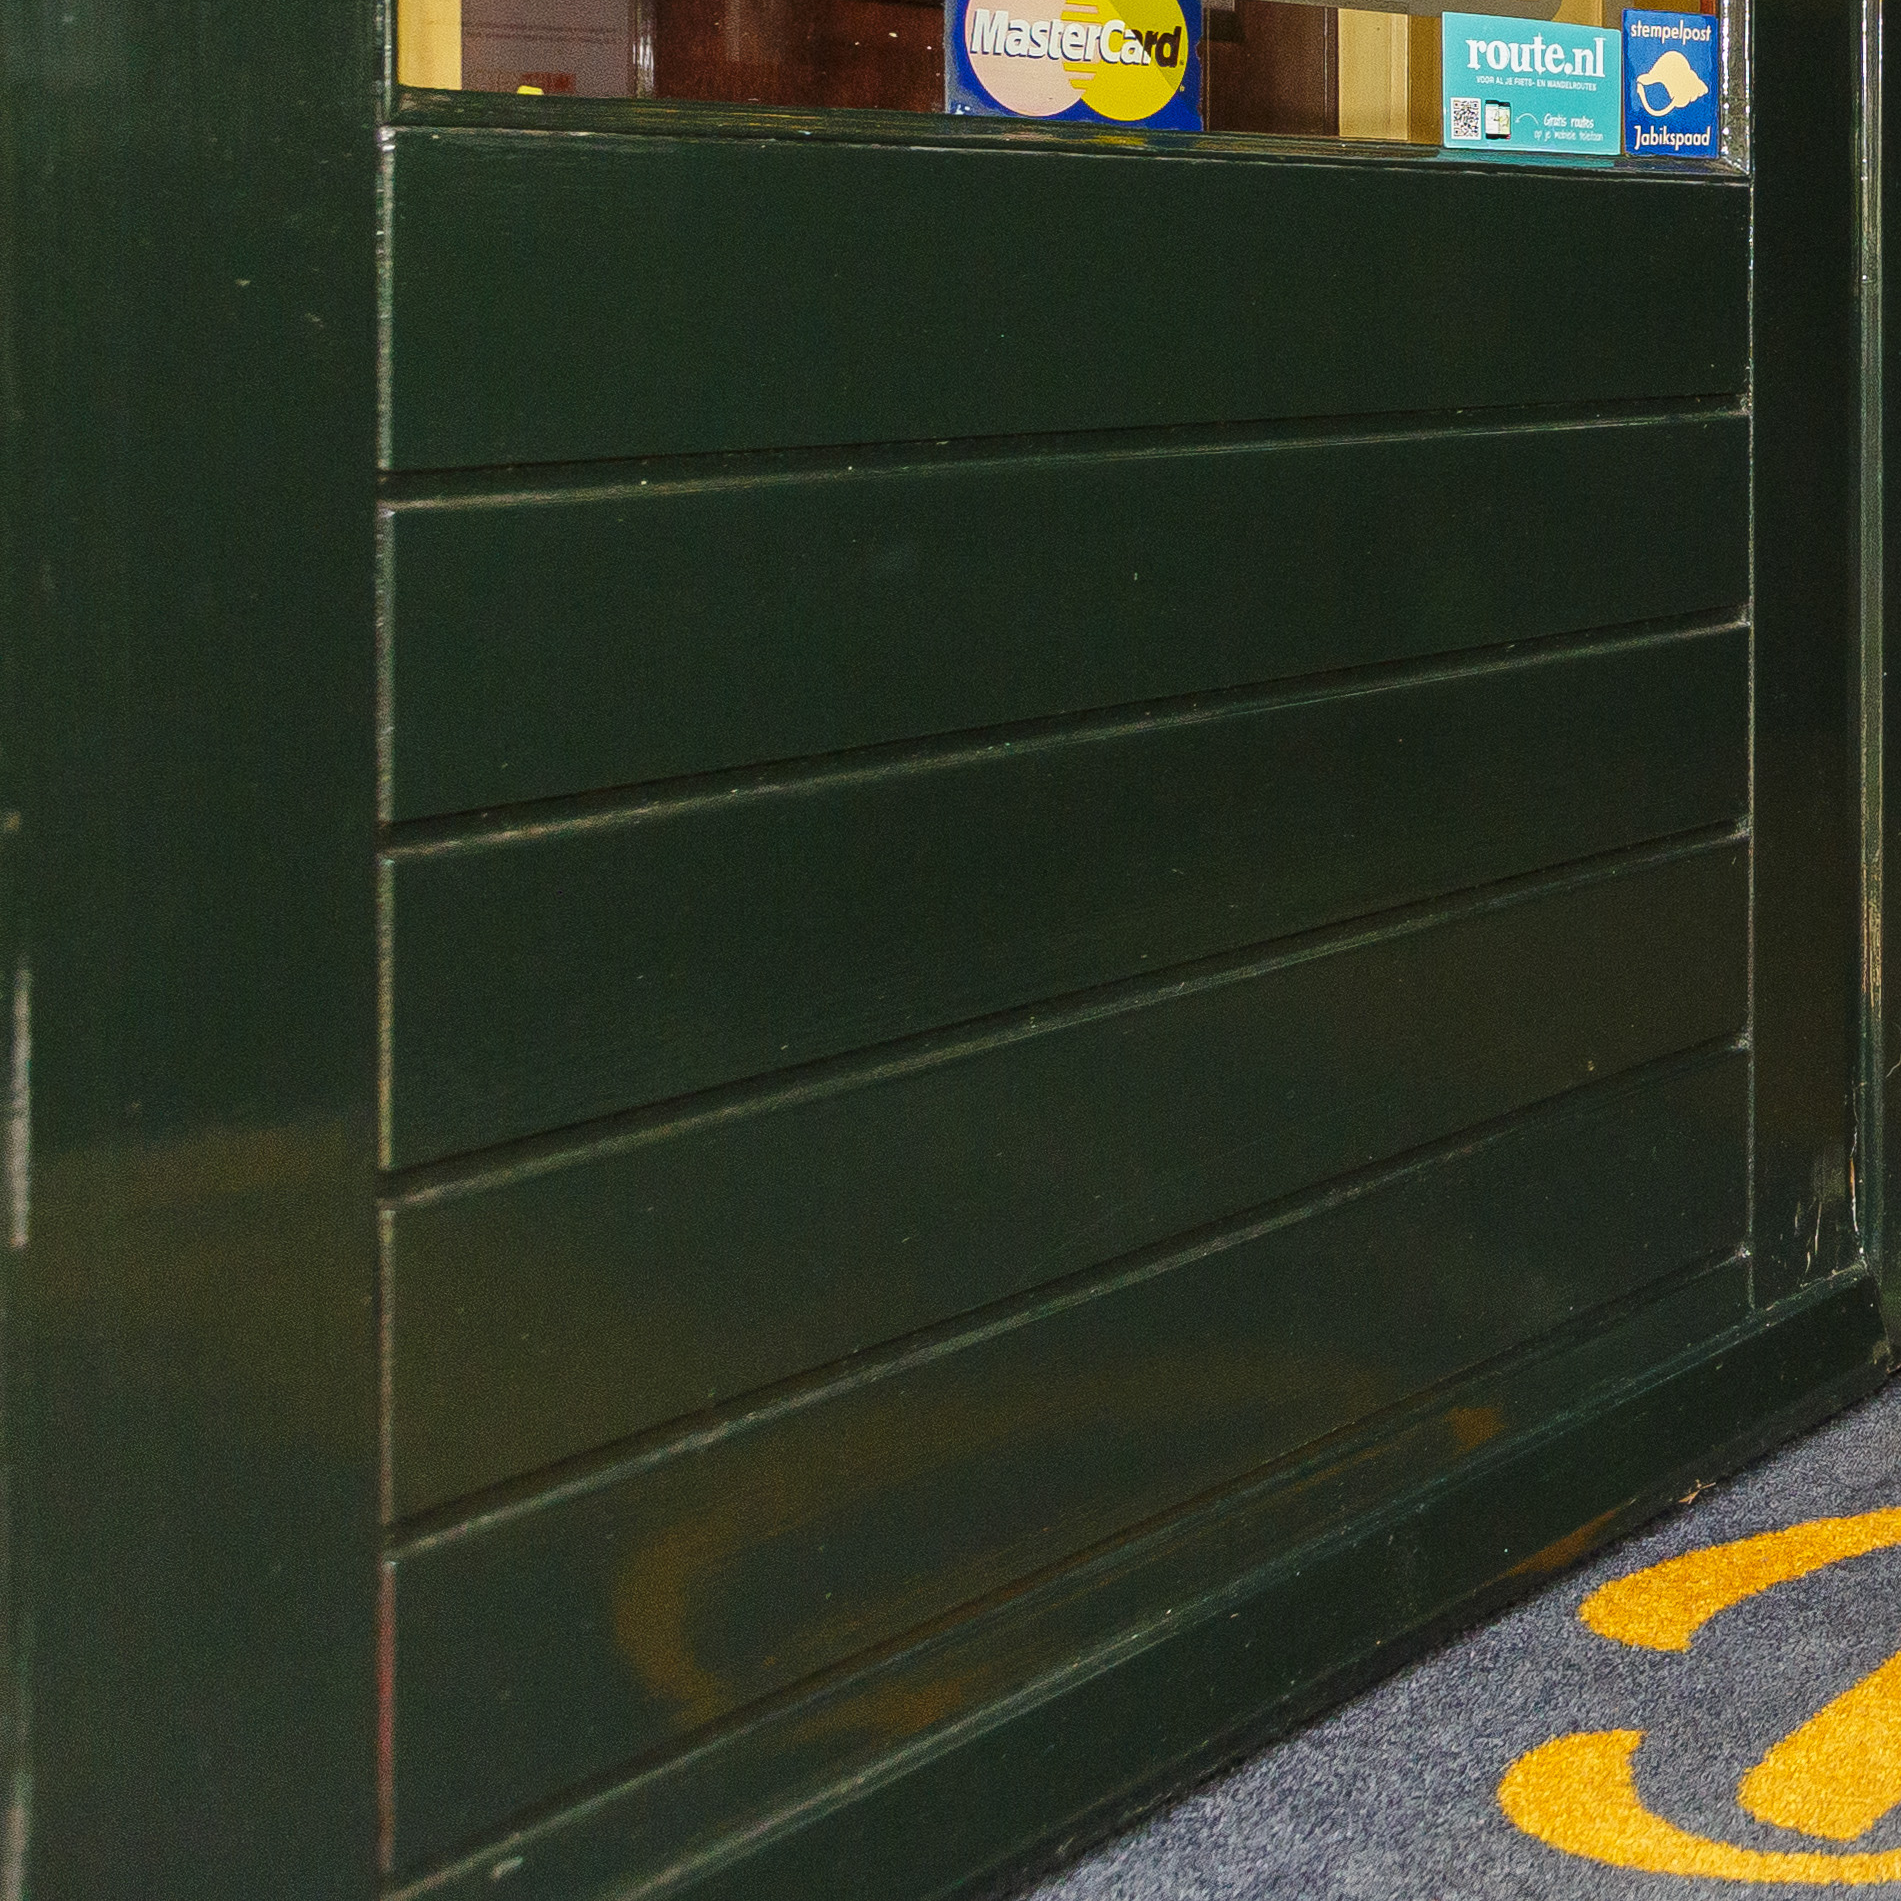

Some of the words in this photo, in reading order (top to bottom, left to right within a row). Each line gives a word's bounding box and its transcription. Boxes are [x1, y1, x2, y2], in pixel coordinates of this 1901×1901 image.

[969, 7, 1183, 69] MasterCard
[1630, 19, 1712, 45] stempelpost
[1465, 32, 1607, 78] route.nl
[1476, 75, 1495, 84] VOOR
[1536, 79, 1546, 88] EN
[1546, 81, 1597, 92] WANDELROUTES
[1543, 113, 1567, 127] Gratis
[1570, 115, 1595, 129] routes
[1633, 125, 1712, 151] Jabikspaad
